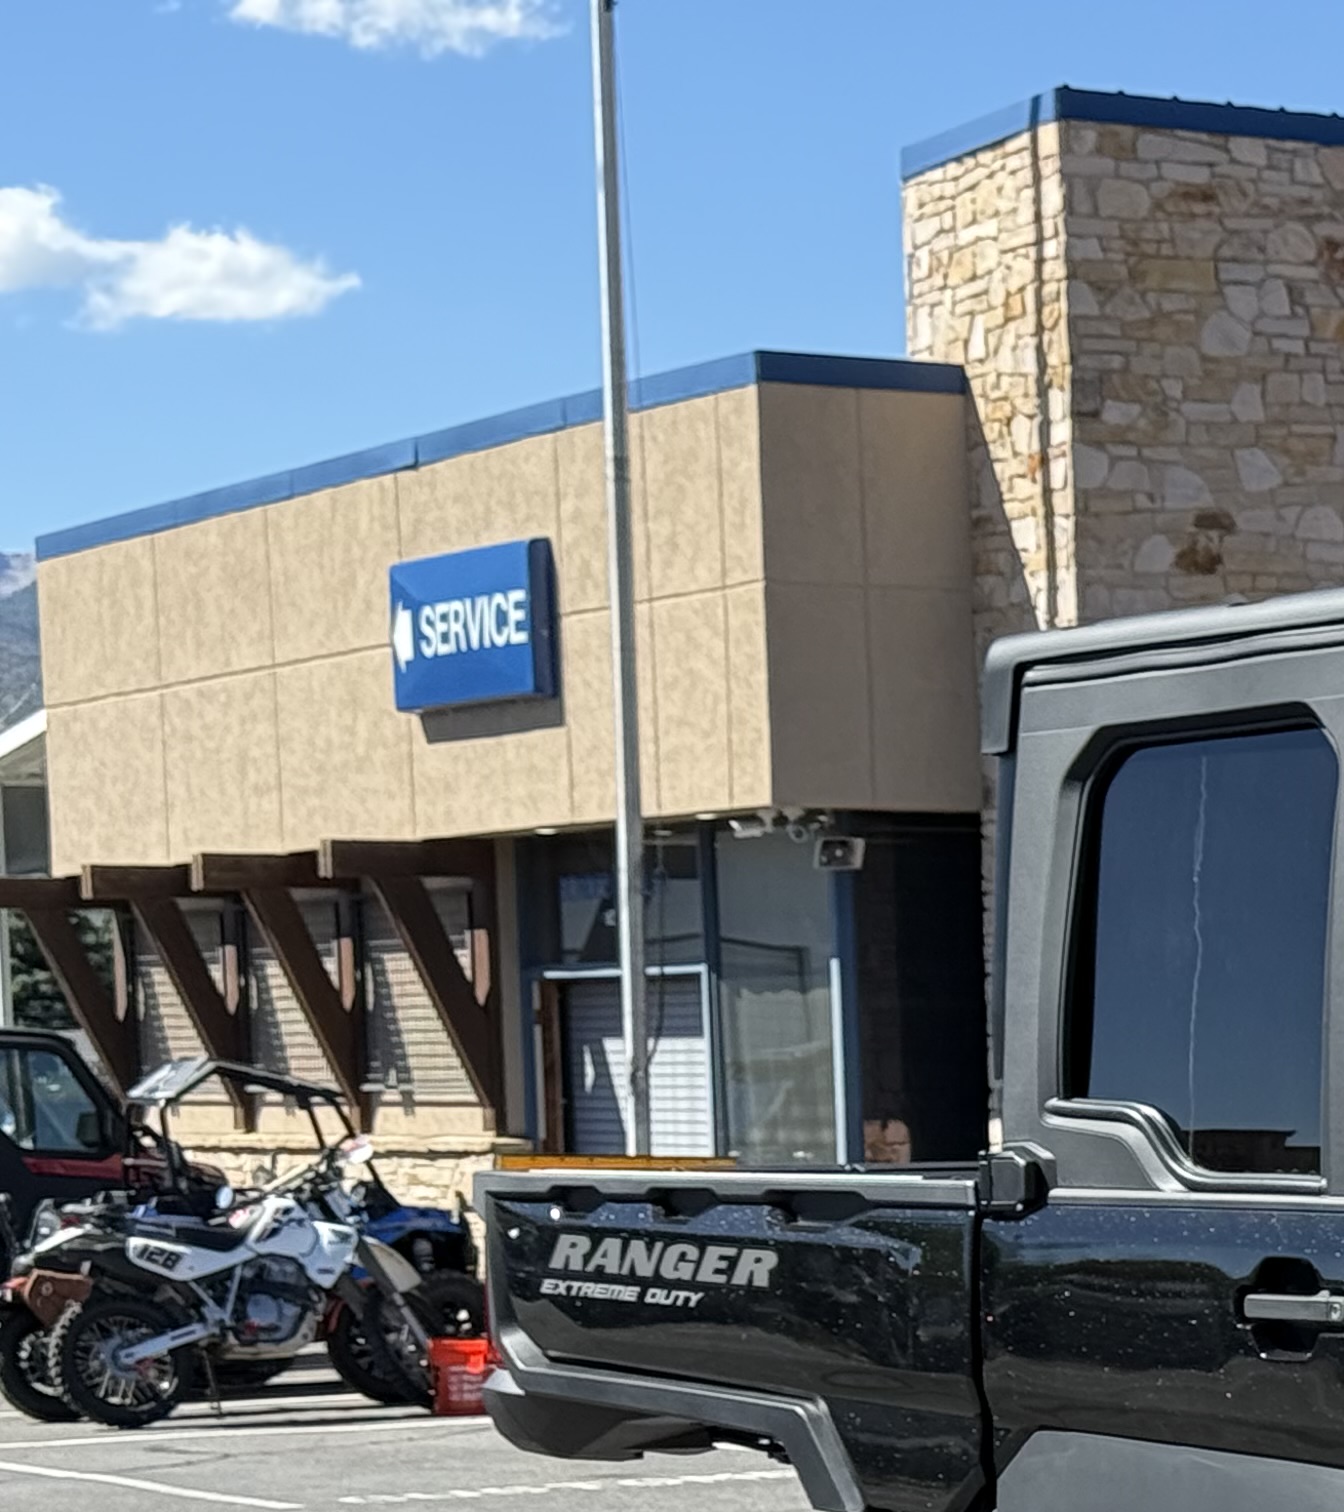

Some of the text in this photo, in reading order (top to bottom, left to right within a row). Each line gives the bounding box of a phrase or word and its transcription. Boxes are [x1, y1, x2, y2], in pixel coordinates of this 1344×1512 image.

[419, 588, 528, 659] SERVICE
[136, 1243, 183, 1273] 128
[549, 1232, 779, 1289] RANGER
[539, 1278, 705, 1310] EXTREME DUTY
